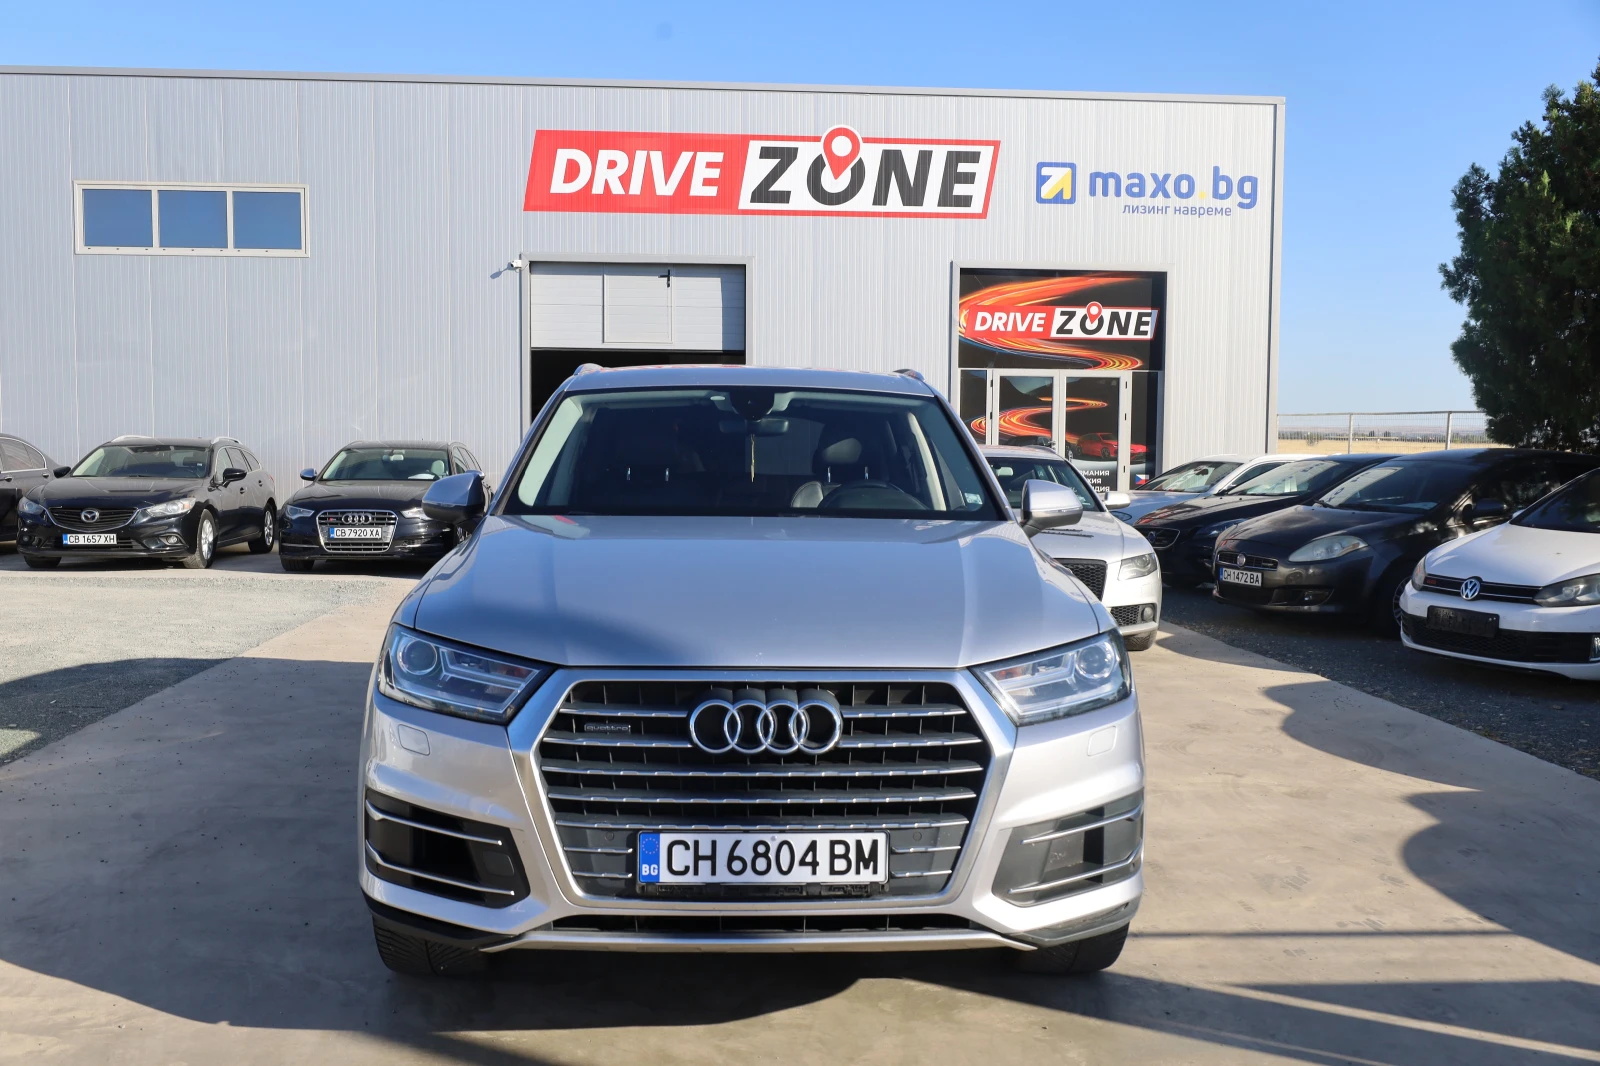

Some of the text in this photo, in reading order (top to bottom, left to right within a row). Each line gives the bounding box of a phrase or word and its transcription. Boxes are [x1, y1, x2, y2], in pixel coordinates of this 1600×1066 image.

[549, 145, 982, 208] DRIVE ZONE
[1088, 165, 1259, 210] maxo.bg
[1122, 203, 1232, 218] лизинг навреме
[974, 310, 1152, 336] DRIVE ZONE
[68, 535, 80, 544] CB
[82, 535, 102, 544] 1657
[103, 535, 115, 543] XH
[335, 528, 347, 537] CB
[348, 528, 368, 537] 7920
[369, 528, 380, 537] XA
[1233, 571, 1249, 583] 1472
[1249, 573, 1260, 585] BA
[666, 839, 879, 876] CH 6804 BM
[641, 863, 659, 876] BG
